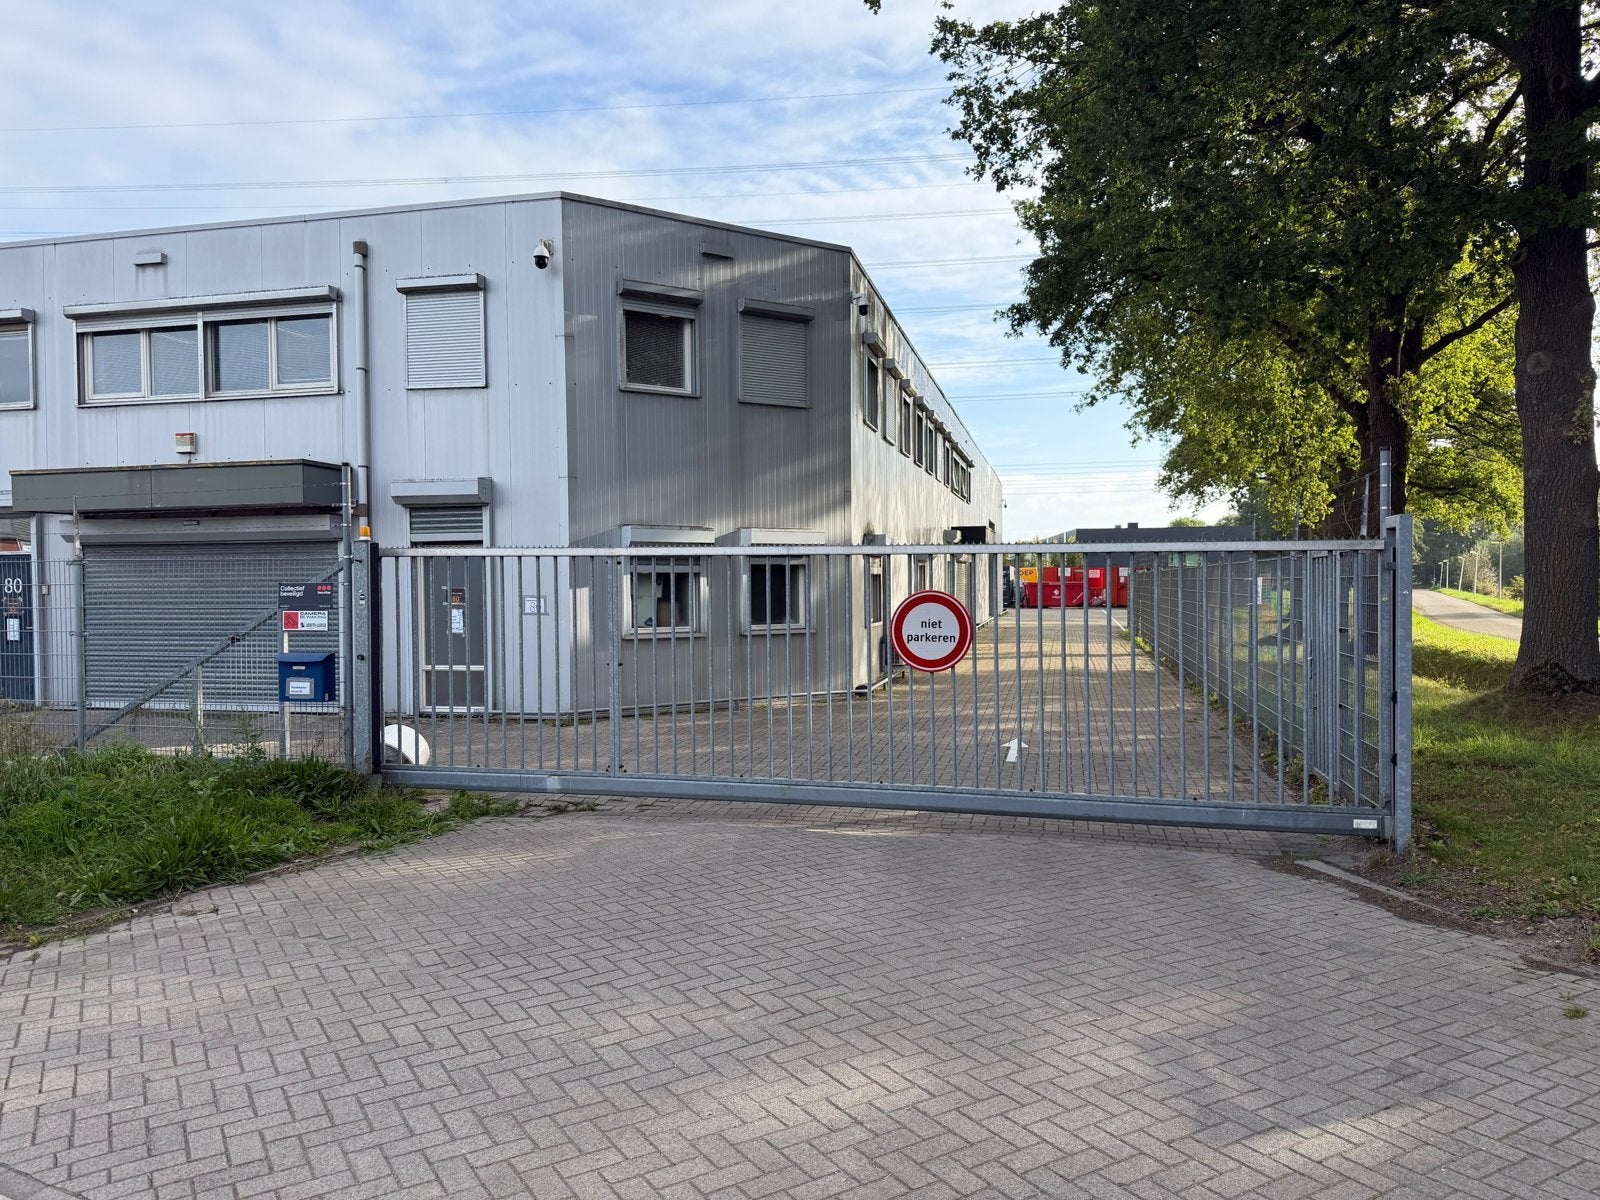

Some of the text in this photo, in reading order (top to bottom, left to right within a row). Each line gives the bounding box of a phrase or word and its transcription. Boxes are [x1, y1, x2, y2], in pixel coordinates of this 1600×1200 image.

[5, 578, 22, 593] 80
[920, 619, 943, 629] niet
[907, 633, 956, 645] parkeren
